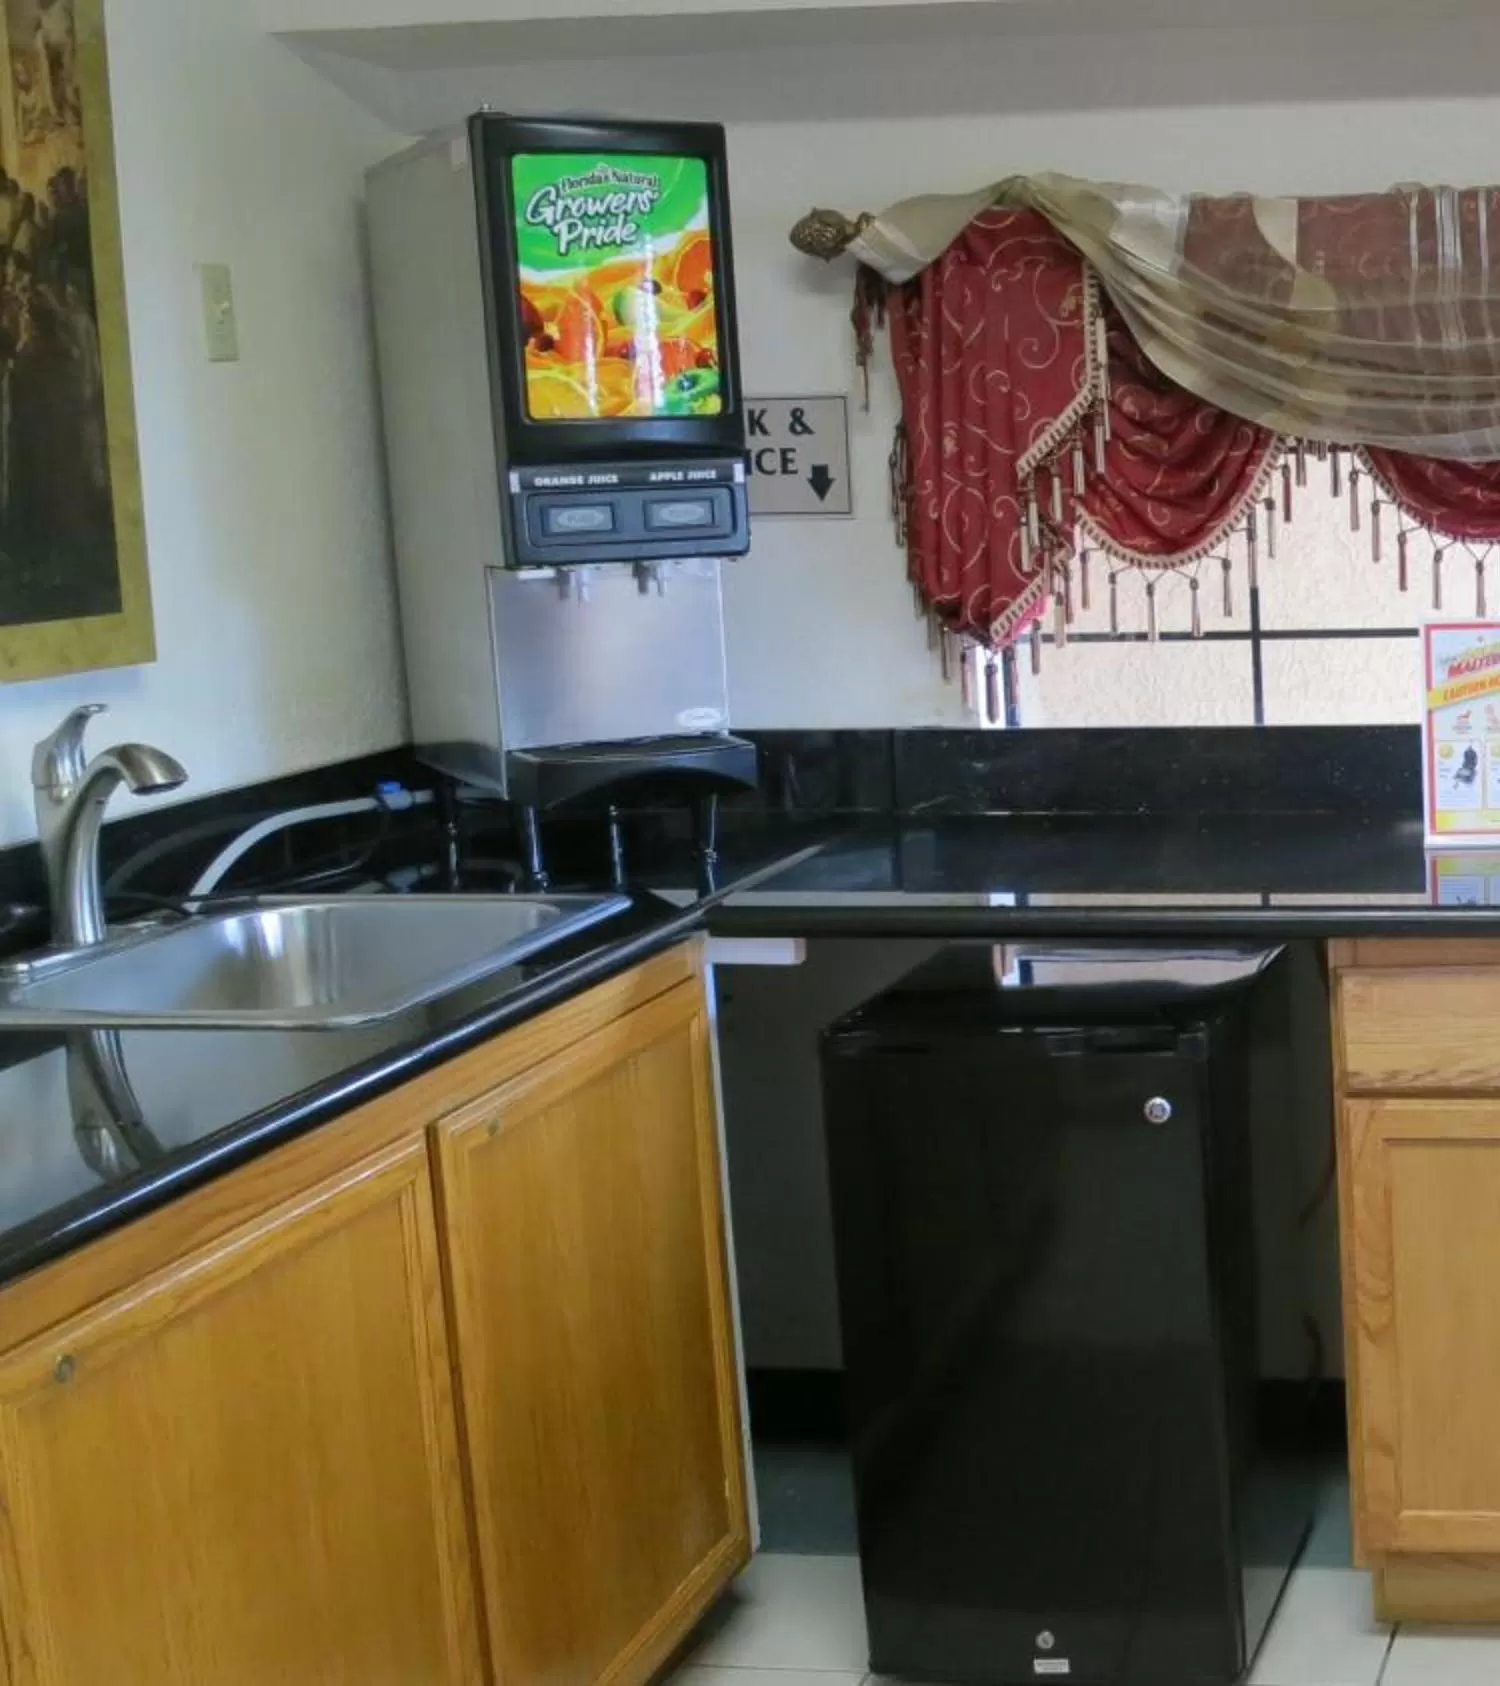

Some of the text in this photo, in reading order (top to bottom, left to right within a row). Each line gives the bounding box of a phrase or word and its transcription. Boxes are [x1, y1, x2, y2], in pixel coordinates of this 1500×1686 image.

[553, 213, 638, 255] Pride
[788, 407, 816, 436] &
[533, 473, 619, 487] ORANGE JUICE
[649, 469, 717, 482] APPLE JUICE
